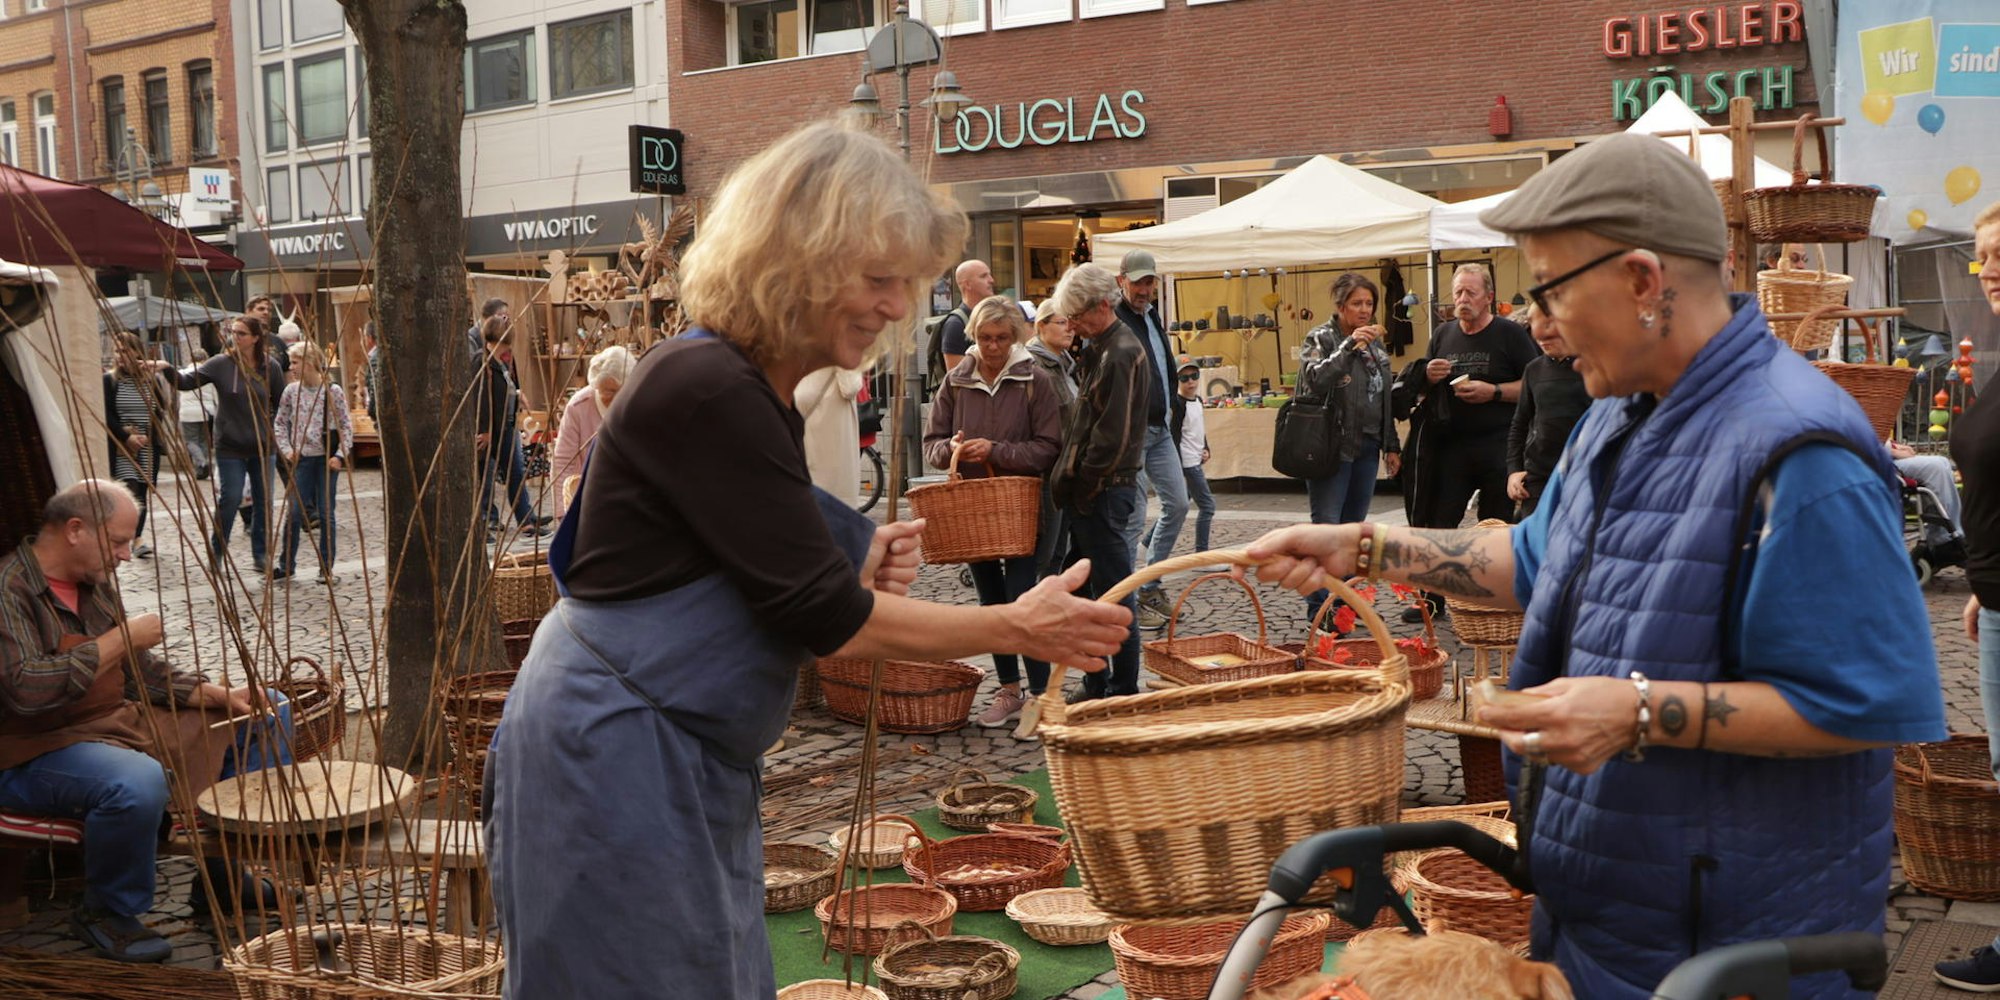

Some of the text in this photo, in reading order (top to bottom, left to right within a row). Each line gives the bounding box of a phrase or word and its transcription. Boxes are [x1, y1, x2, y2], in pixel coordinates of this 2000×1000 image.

[1602, 0, 1802, 58] GIESLER
[1878, 45, 2000, 77] Wir sind
[935, 89, 1147, 154] DOUGLAS
[642, 136, 677, 171] DO
[643, 171, 678, 185] DOUGLAS
